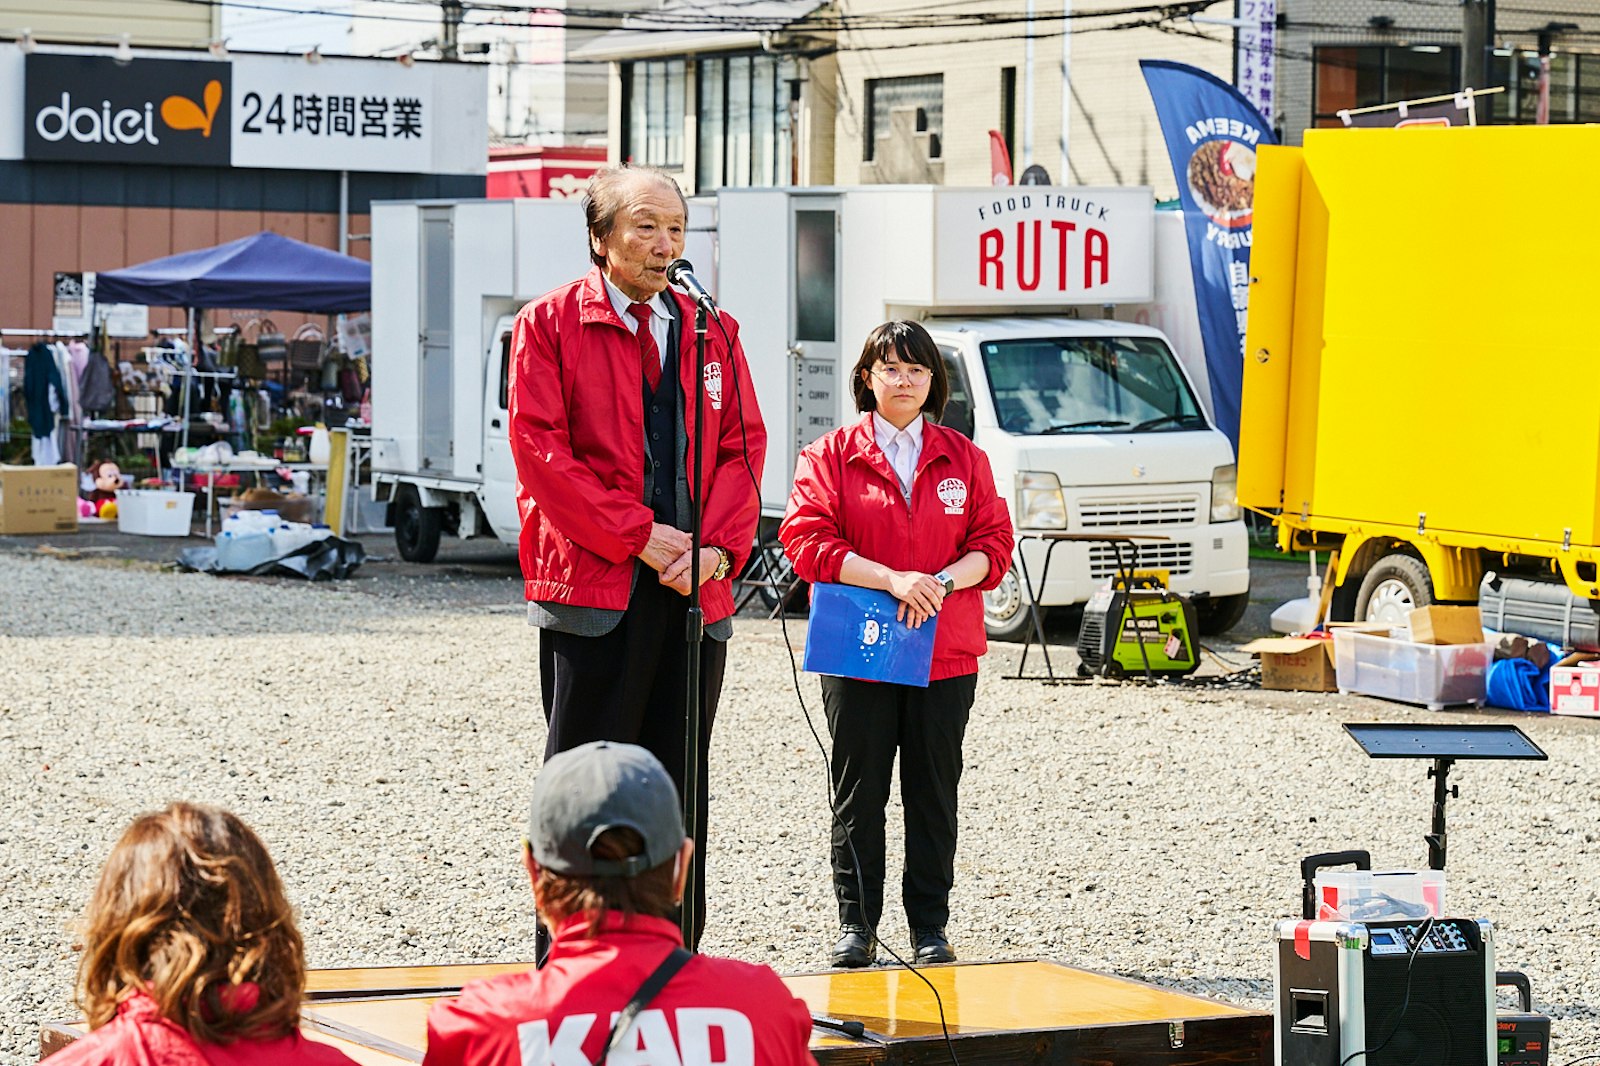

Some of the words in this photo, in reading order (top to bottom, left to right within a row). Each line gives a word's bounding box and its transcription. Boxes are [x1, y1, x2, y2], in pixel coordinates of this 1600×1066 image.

[1244, 1, 1256, 98] フットネス
[35, 91, 160, 145] daiei
[242, 91, 422, 139] 24時間営業
[978, 195, 1031, 220] FOOD
[1044, 194, 1110, 221] TRUCK
[979, 219, 1109, 291] RUTA
[808, 364, 834, 375] COFFEE
[808, 391, 830, 401] CURRY
[808, 416, 835, 427] SWEETS
